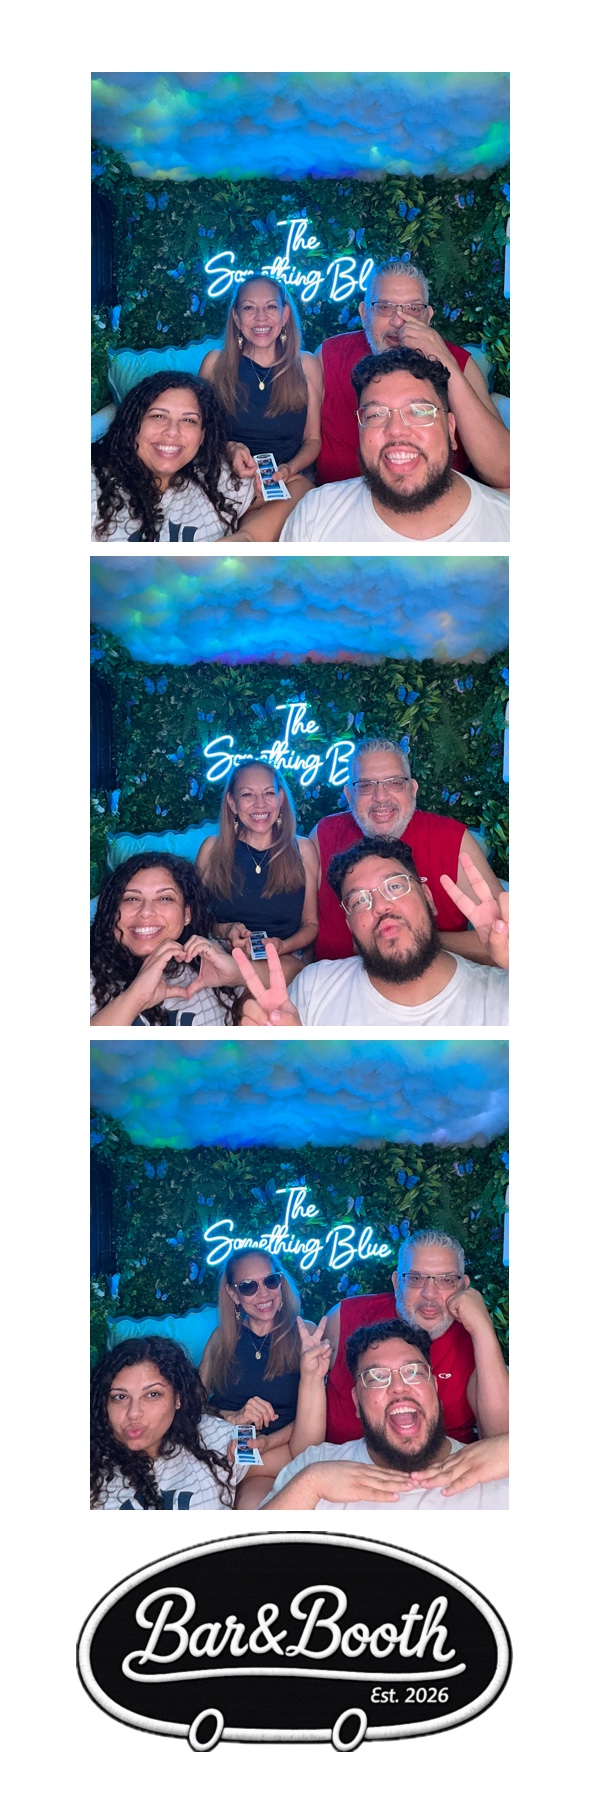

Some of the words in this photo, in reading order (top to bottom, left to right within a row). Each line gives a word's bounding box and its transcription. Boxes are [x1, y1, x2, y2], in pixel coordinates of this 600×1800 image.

[276, 218, 321, 258] The
[326, 256, 375, 301] Bl
[276, 702, 320, 743] The
[276, 1187, 320, 1227] The
[203, 1219, 324, 1270] Something
[326, 1225, 392, 1270] Blue
